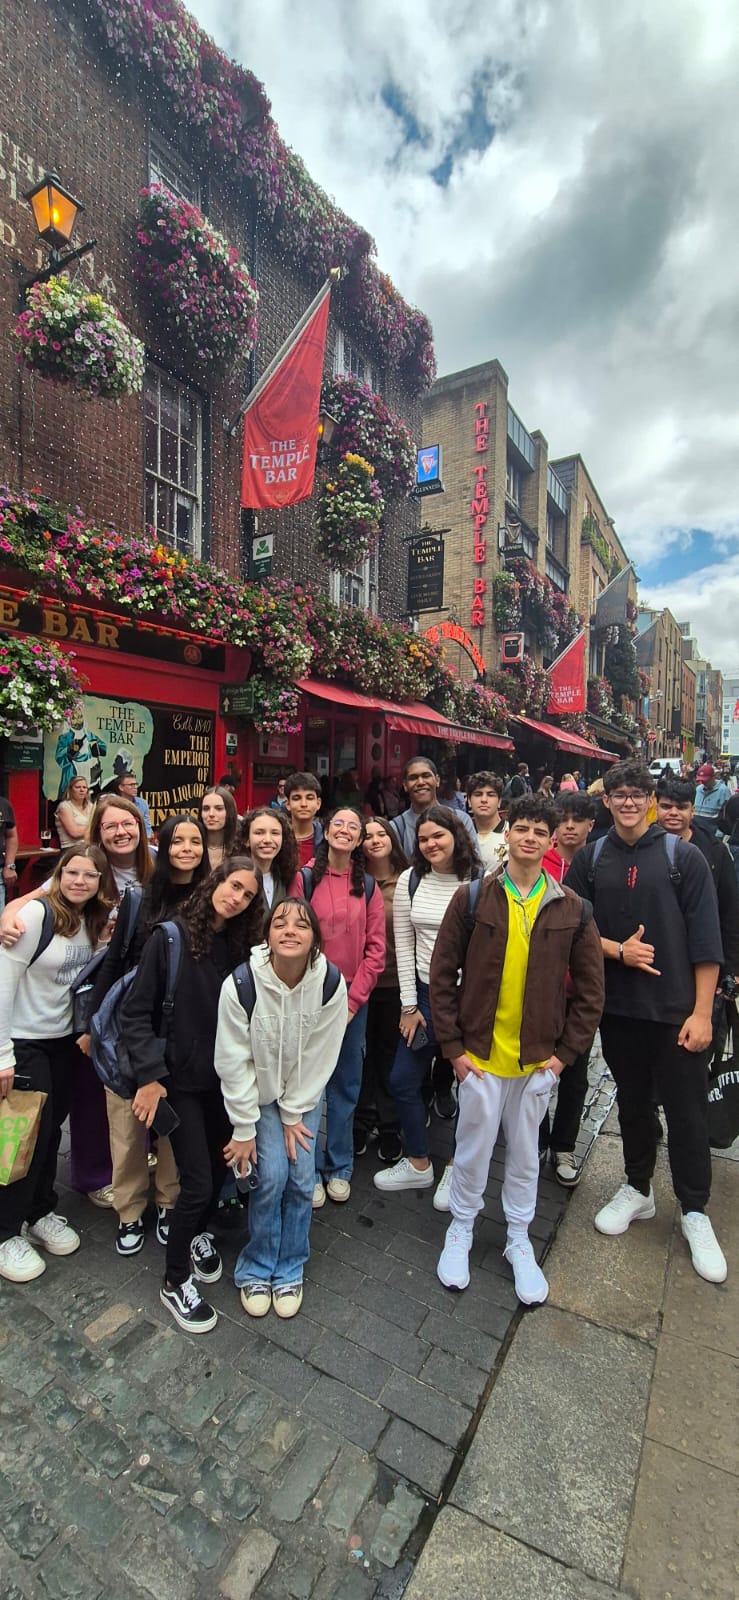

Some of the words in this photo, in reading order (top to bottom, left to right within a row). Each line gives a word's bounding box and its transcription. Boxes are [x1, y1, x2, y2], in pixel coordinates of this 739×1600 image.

[475, 401, 489, 452] THE
[270, 439, 296, 453] THE
[249, 444, 310, 470] TEMPLE
[265, 467, 297, 484] BAR
[471, 465, 489, 564] TEMPLE
[417, 555, 436, 564] BAR
[472, 577, 487, 627] BAR
[43, 609, 120, 648] BAR
[551, 689, 582, 699] TEMPLE
[109, 705, 135, 720] THE
[96, 717, 146, 734] TEMPLE
[109, 731, 135, 746] BAR
[189, 735, 210, 751] THE
[164, 749, 210, 767] EMPEROR
[197, 767, 209, 782] OF
